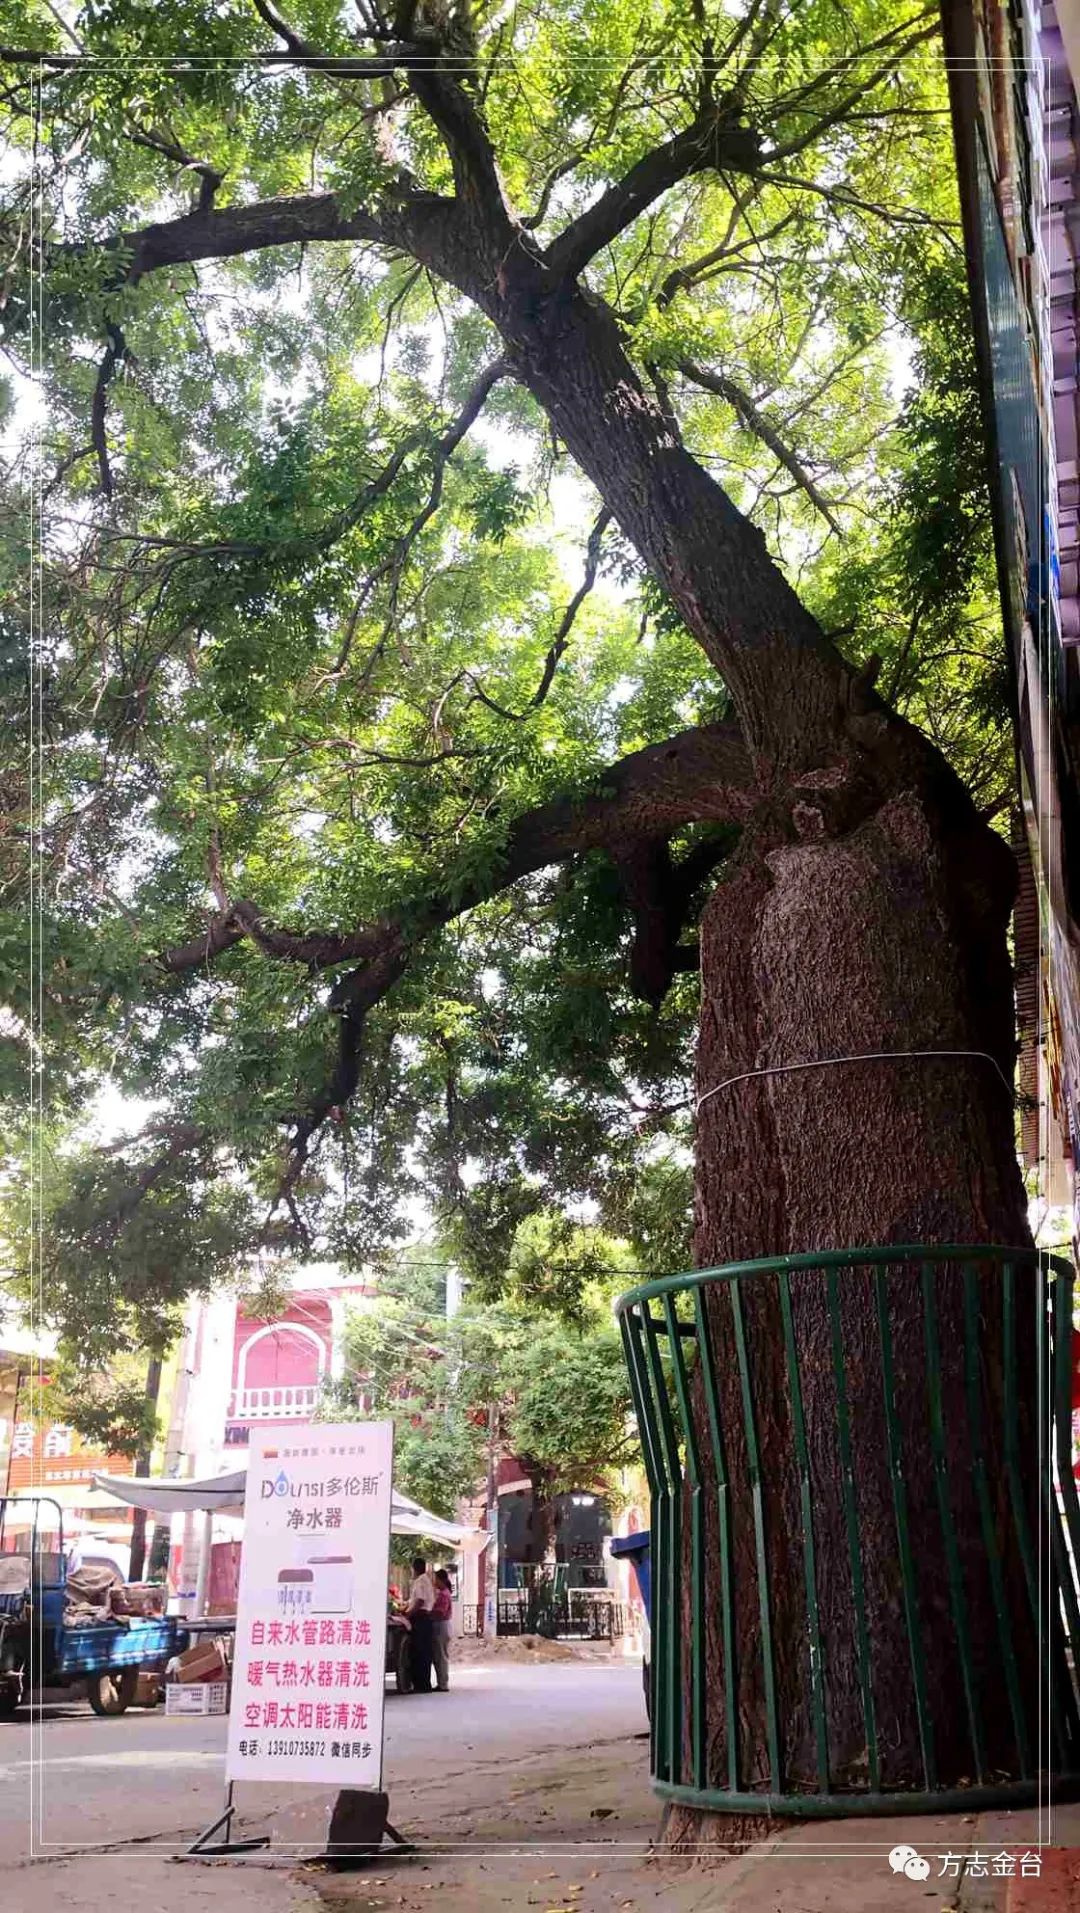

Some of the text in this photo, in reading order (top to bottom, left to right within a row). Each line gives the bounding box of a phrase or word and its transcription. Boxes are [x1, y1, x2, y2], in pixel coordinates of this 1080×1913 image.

[326, 1476, 379, 1497] 多伦斯
[286, 1507, 343, 1529] 净水器
[250, 1619, 372, 1646] 自来水管路清洗
[247, 1660, 371, 1688] 暖气热水器清洗
[243, 1702, 369, 1731] 空调太阳能清洗
[268, 1740, 326, 1757] 13910735872
[331, 1741, 373, 1759] 微信同步
